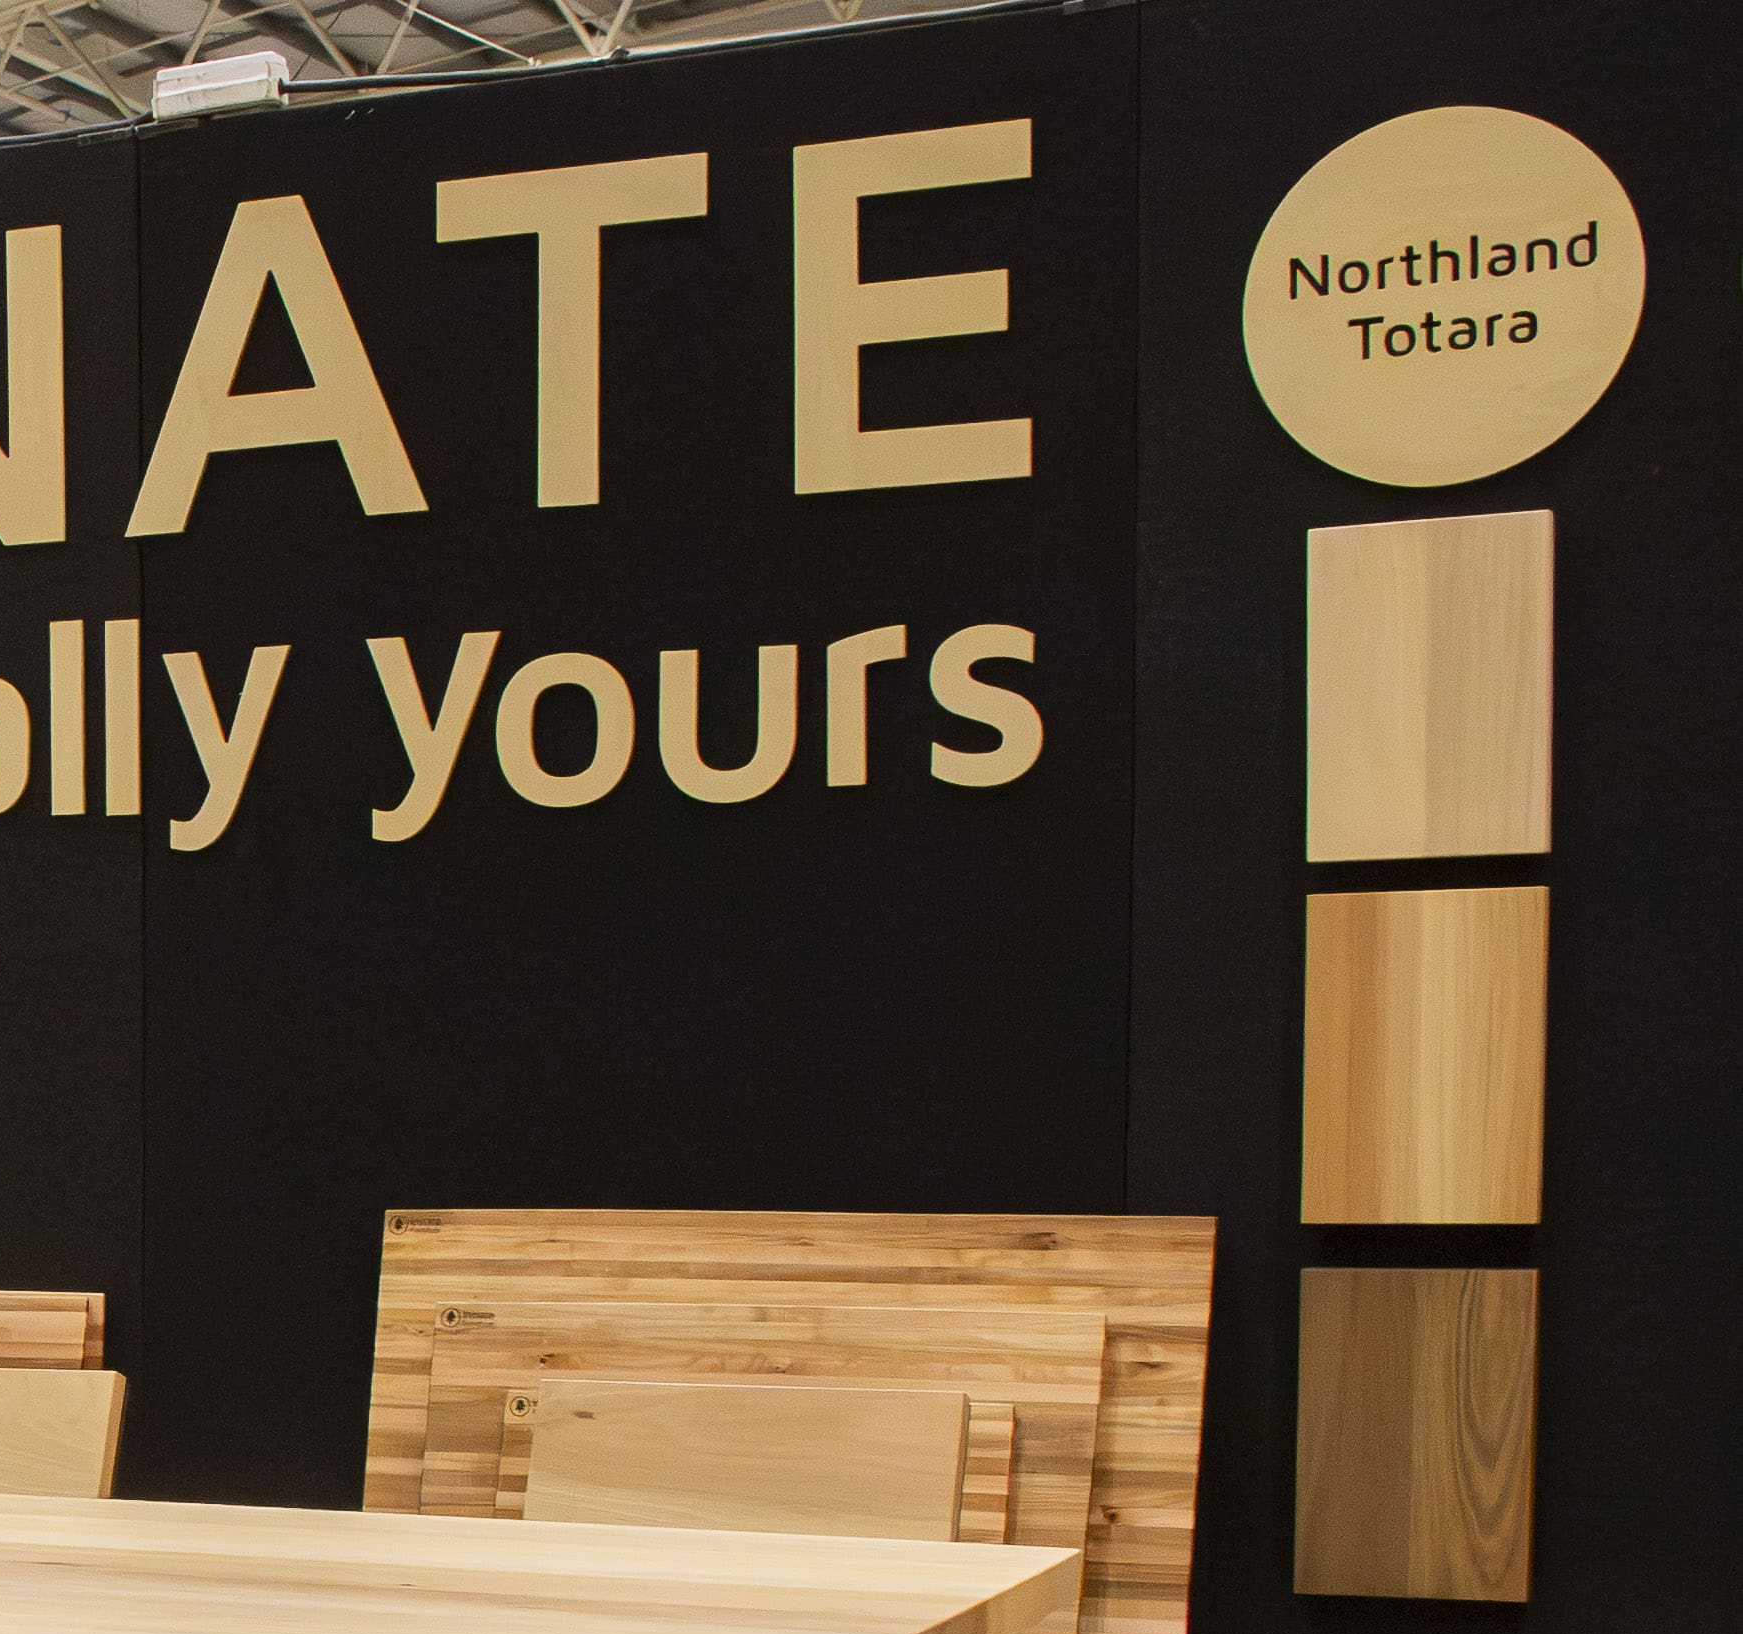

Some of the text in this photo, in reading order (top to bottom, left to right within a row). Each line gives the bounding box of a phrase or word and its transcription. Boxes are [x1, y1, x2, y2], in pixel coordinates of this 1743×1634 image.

[1288, 220, 1599, 300] Northland
[1348, 309, 1539, 360] Totara
[365, 622, 1045, 843] yours
